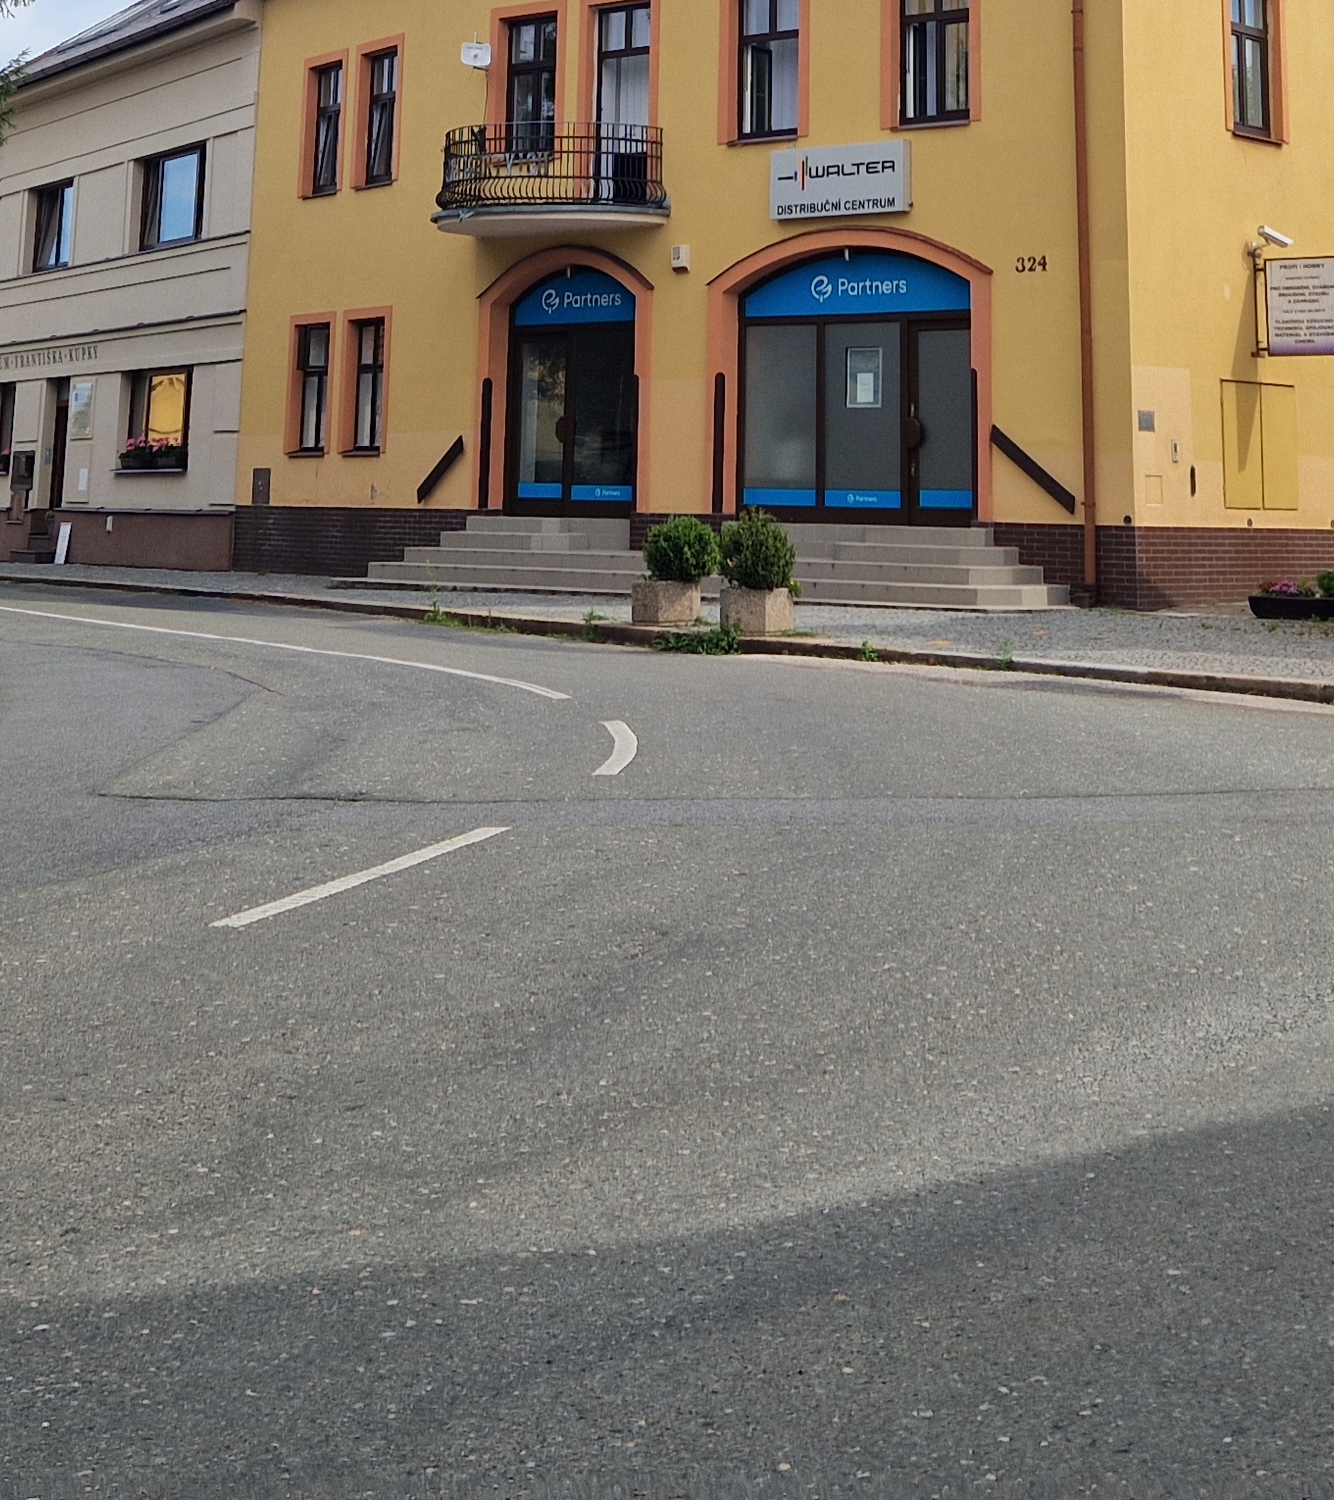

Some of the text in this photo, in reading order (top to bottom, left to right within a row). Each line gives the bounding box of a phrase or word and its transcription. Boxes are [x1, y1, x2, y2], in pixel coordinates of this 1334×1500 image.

[808, 160, 896, 179] WALTER
[777, 197, 896, 216] DISTRIBUČNÍ CENTRUM
[1015, 255, 1048, 273] 324
[837, 278, 907, 297] Partners
[563, 291, 622, 308] Partners
[68, 345, 99, 362] KUPKY
